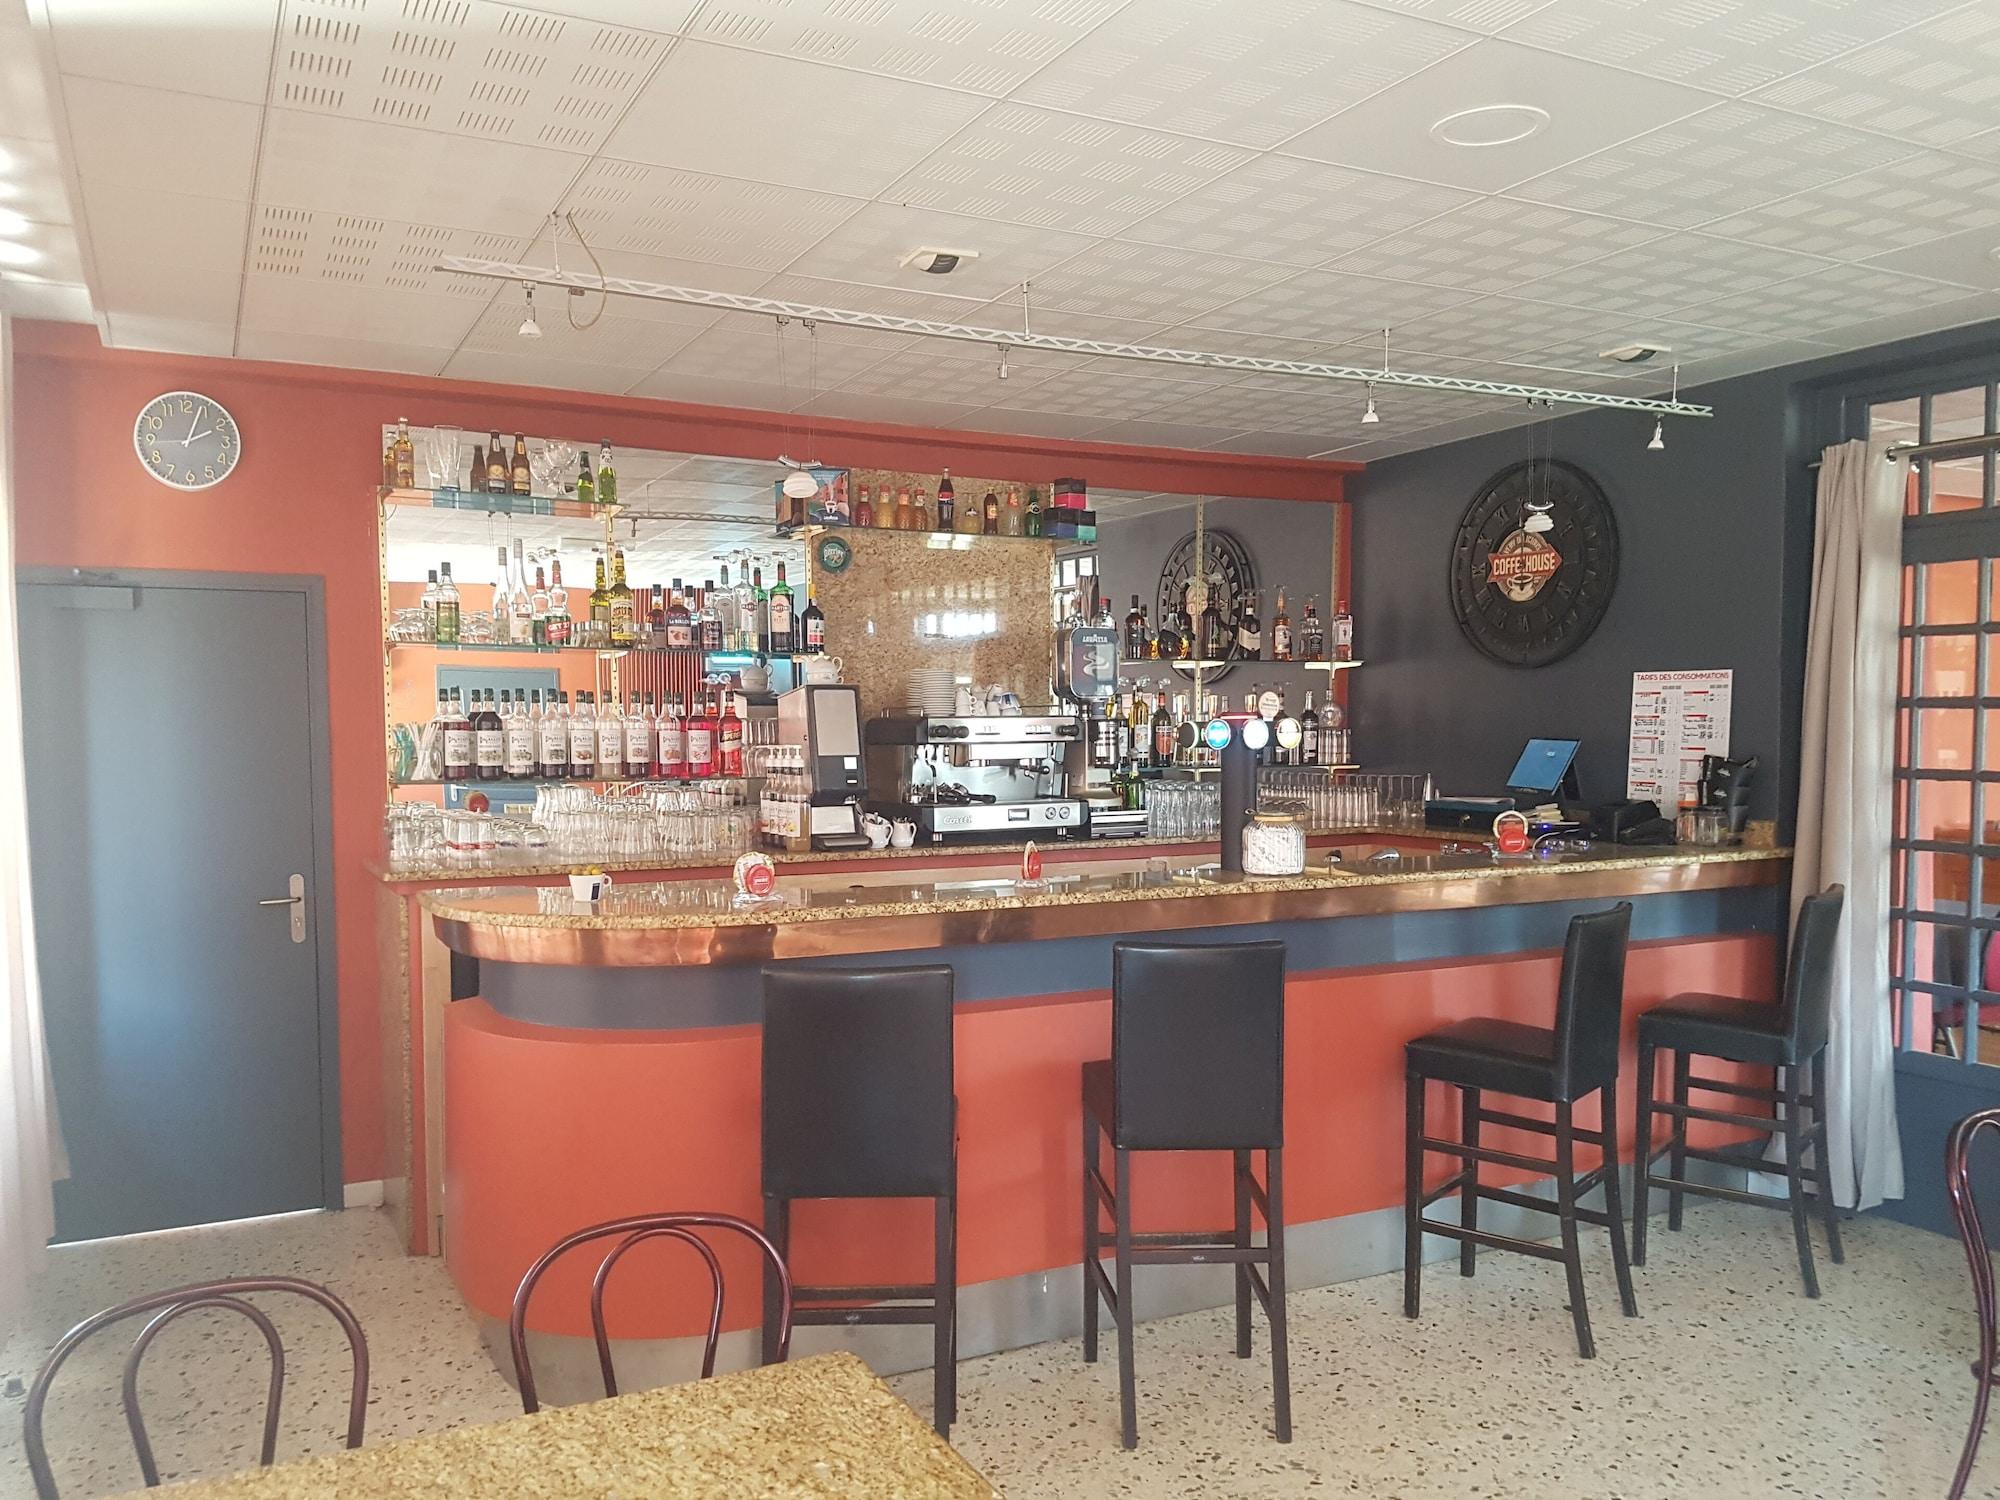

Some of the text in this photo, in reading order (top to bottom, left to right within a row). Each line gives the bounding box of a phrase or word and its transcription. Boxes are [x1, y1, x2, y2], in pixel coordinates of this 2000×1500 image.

[162, 403, 173, 417] 11
[178, 400, 193, 414] 12
[145, 415, 163, 430] 10
[215, 418, 226, 432] 2
[145, 433, 157, 446] 9
[221, 435, 231, 449] 3
[152, 450, 162, 464] 8
[217, 452, 226, 465] 4
[167, 464, 176, 477] 7
[185, 470, 196, 482] 6
[204, 465, 215, 479] 5
[1526, 553, 1556, 573] HOUSE
[1637, 672, 1730, 681] TARIFS DES CONSOMMATIONS
